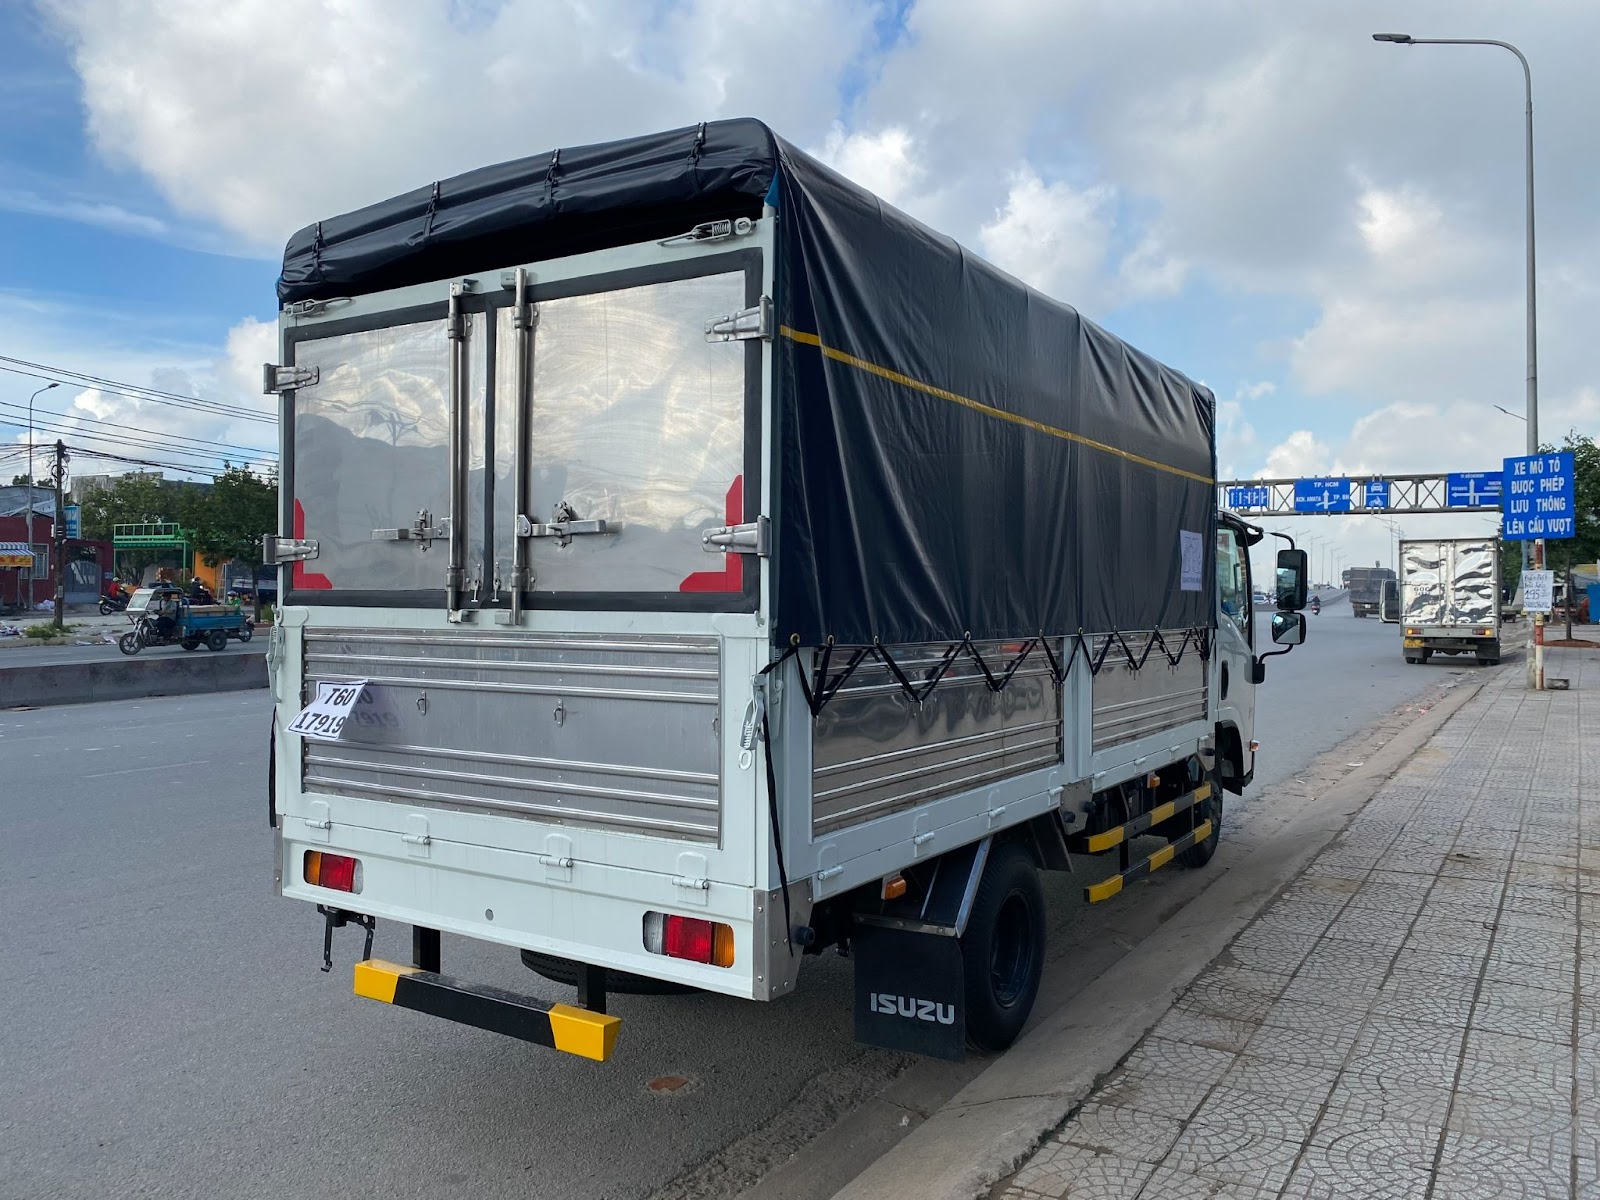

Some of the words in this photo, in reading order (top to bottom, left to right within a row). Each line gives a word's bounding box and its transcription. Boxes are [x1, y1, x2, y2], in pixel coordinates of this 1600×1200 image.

[1514, 462, 1526, 476] XE
[1529, 457, 1544, 475] MÔ
[1548, 456, 1561, 473] TÔ
[1540, 474, 1565, 493] PHÉP
[1510, 499, 1529, 514] LƯU
[1535, 495, 1566, 513] THÔNG
[1506, 518, 1525, 535] LÊN
[1528, 515, 1544, 534] CẦU
[1547, 517, 1572, 536] VƯỢT
[324, 688, 356, 707] T60
[294, 711, 347, 734] 17919
[870, 992, 955, 1025] ISUZU
